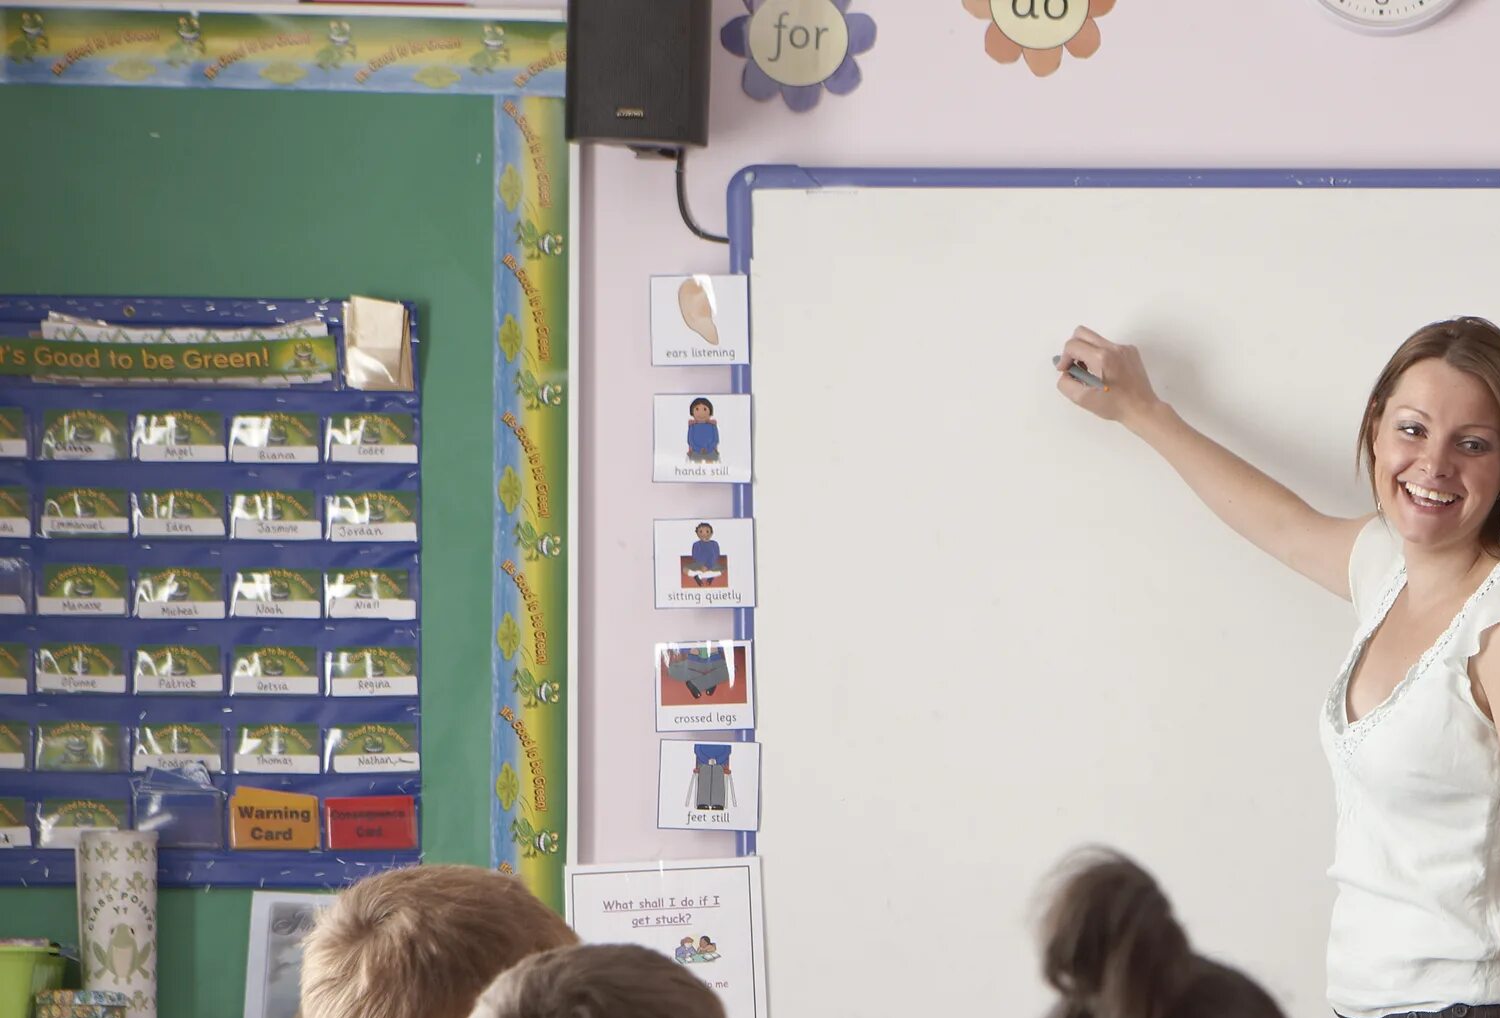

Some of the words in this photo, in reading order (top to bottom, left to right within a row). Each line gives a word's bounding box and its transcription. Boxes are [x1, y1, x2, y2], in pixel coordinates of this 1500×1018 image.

[768, 13, 829, 62] for
[34, 347, 100, 369] Good
[109, 351, 134, 369] to
[142, 348, 175, 370] be
[183, 347, 270, 370] Green!
[666, 350, 687, 358] ears
[691, 349, 735, 360] listening
[675, 467, 706, 476] hands
[711, 467, 729, 476] still
[339, 526, 383, 537] Jordan
[668, 590, 701, 604] sitting
[705, 590, 741, 604] quietly
[358, 680, 391, 694] Regina
[674, 712, 713, 724] crossed
[716, 712, 737, 727] legs
[238, 806, 311, 822] Warning
[686, 812, 706, 825] feet
[711, 812, 730, 823] still
[251, 827, 293, 841] Card
[603, 899, 633, 911] What
[639, 898, 664, 909] shall
[670, 897, 676, 907] I
[680, 897, 694, 907] do
[699, 896, 709, 906] if
[713, 895, 720, 905] I
[632, 915, 650, 928] get
[656, 913, 691, 925] stuck?
[715, 980, 729, 988] me
